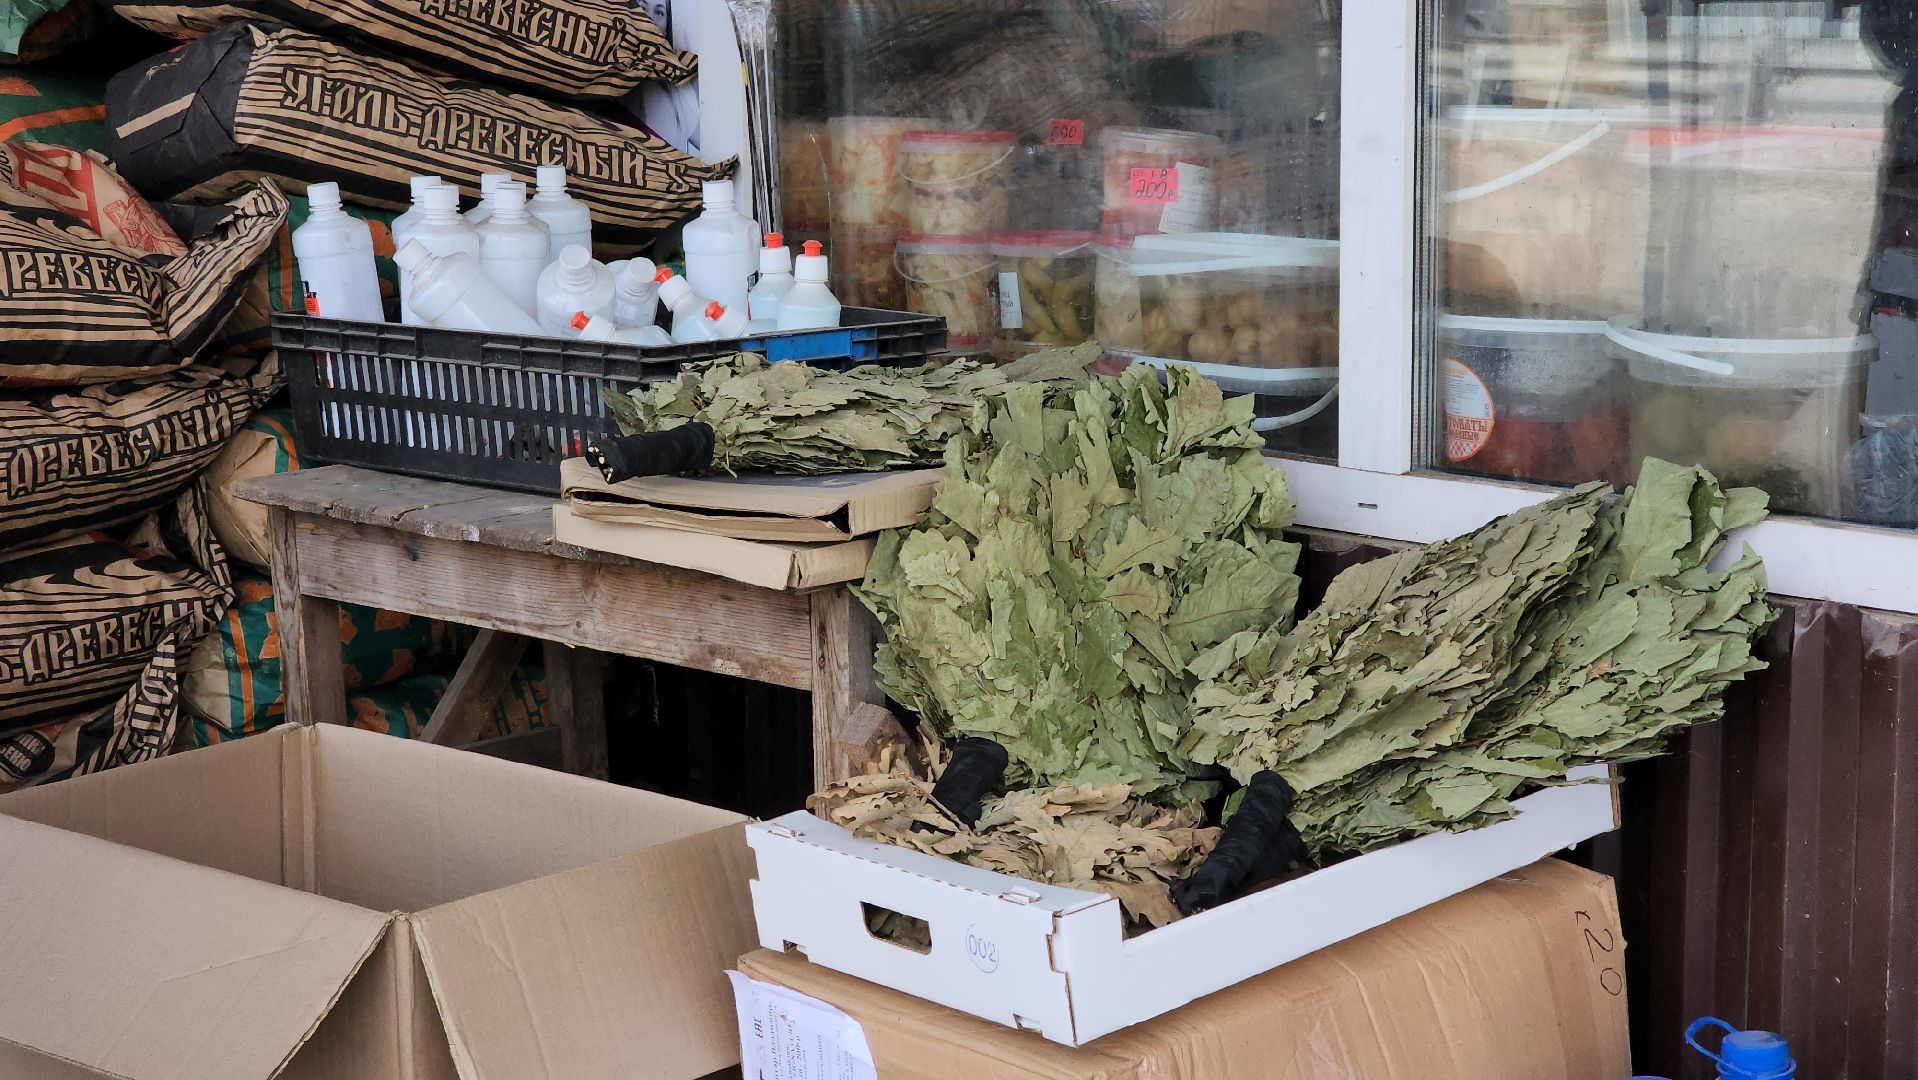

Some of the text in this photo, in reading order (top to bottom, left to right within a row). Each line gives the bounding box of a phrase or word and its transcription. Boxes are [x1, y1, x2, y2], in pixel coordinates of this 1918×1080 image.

[283, 68, 409, 136] УГОЛЬ
[420, 105, 645, 188] ДРЕВЕСНЫЙ
[9, 389, 233, 499] ДРЕВЕСНЫЙ
